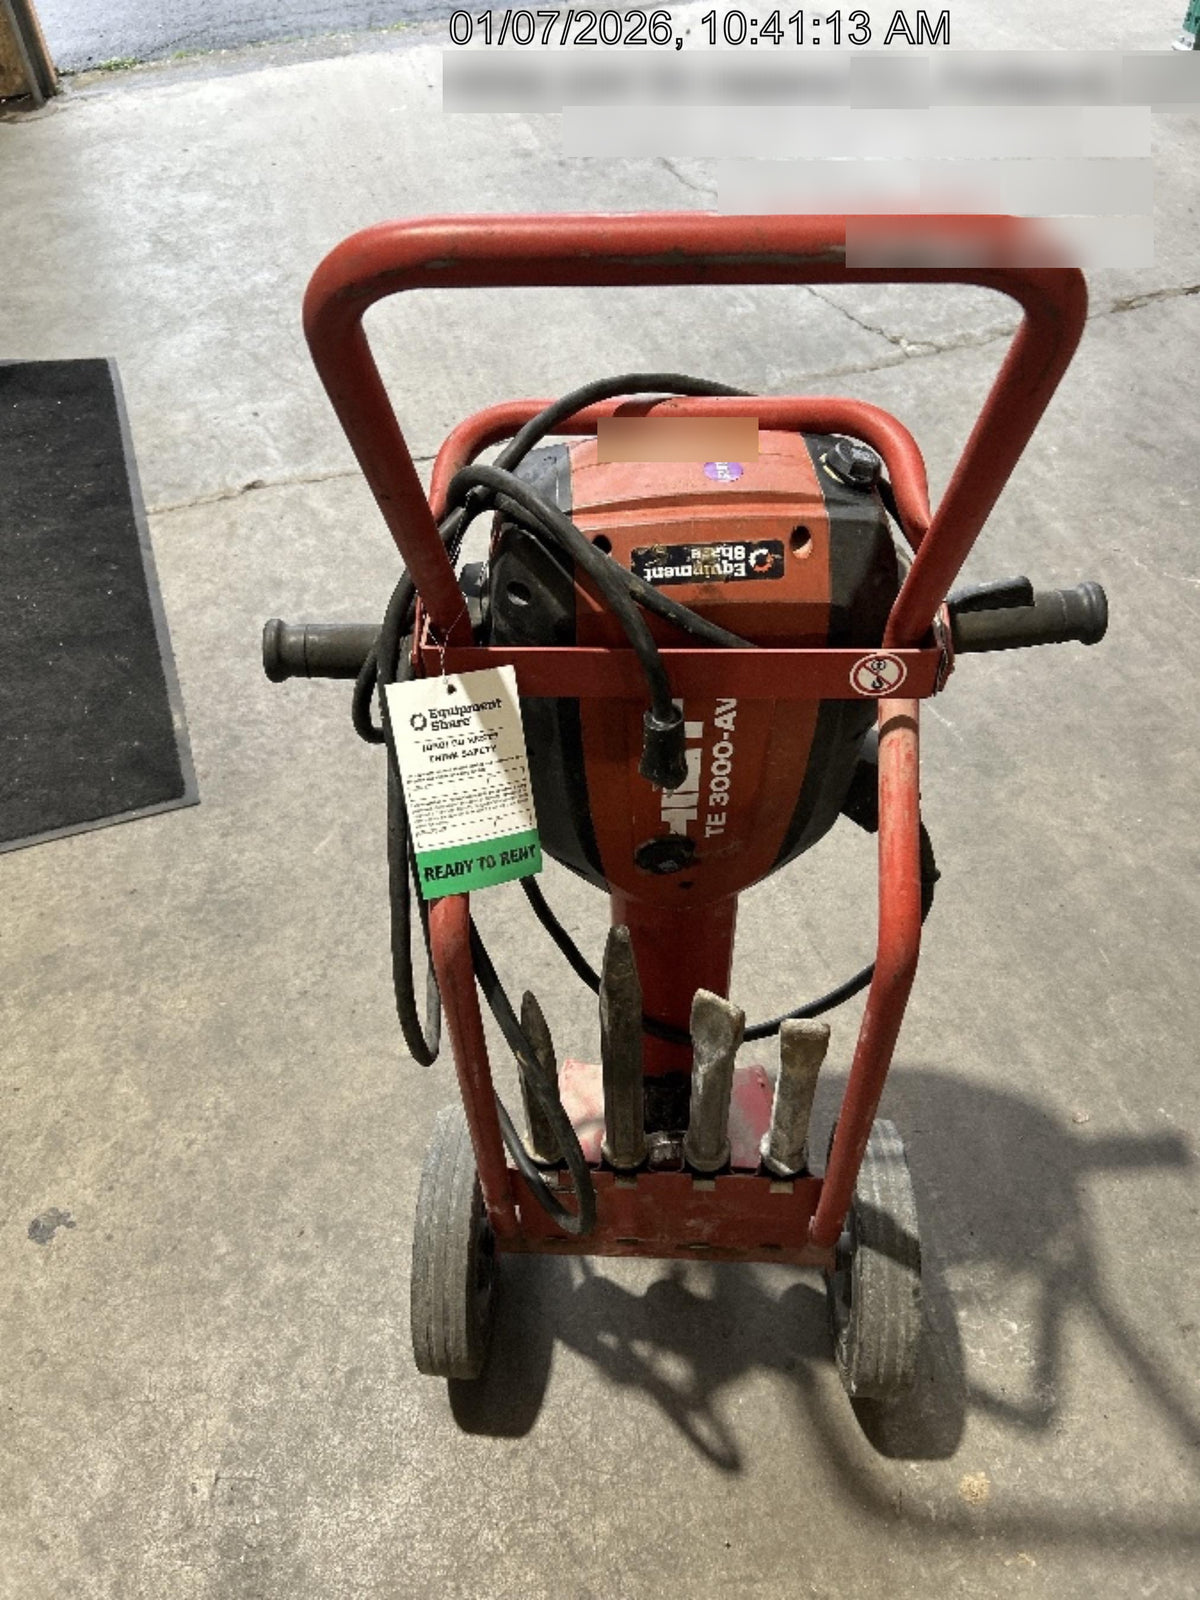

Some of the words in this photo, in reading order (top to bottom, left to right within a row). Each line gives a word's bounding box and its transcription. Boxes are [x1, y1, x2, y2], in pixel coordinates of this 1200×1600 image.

[643, 559, 746, 582] Equipment
[428, 698, 502, 719] Equipment
[431, 717, 470, 731] Share
[704, 812, 727, 838] TE
[424, 859, 474, 882] READY
[476, 855, 496, 871] TO
[500, 844, 536, 865] RENT
